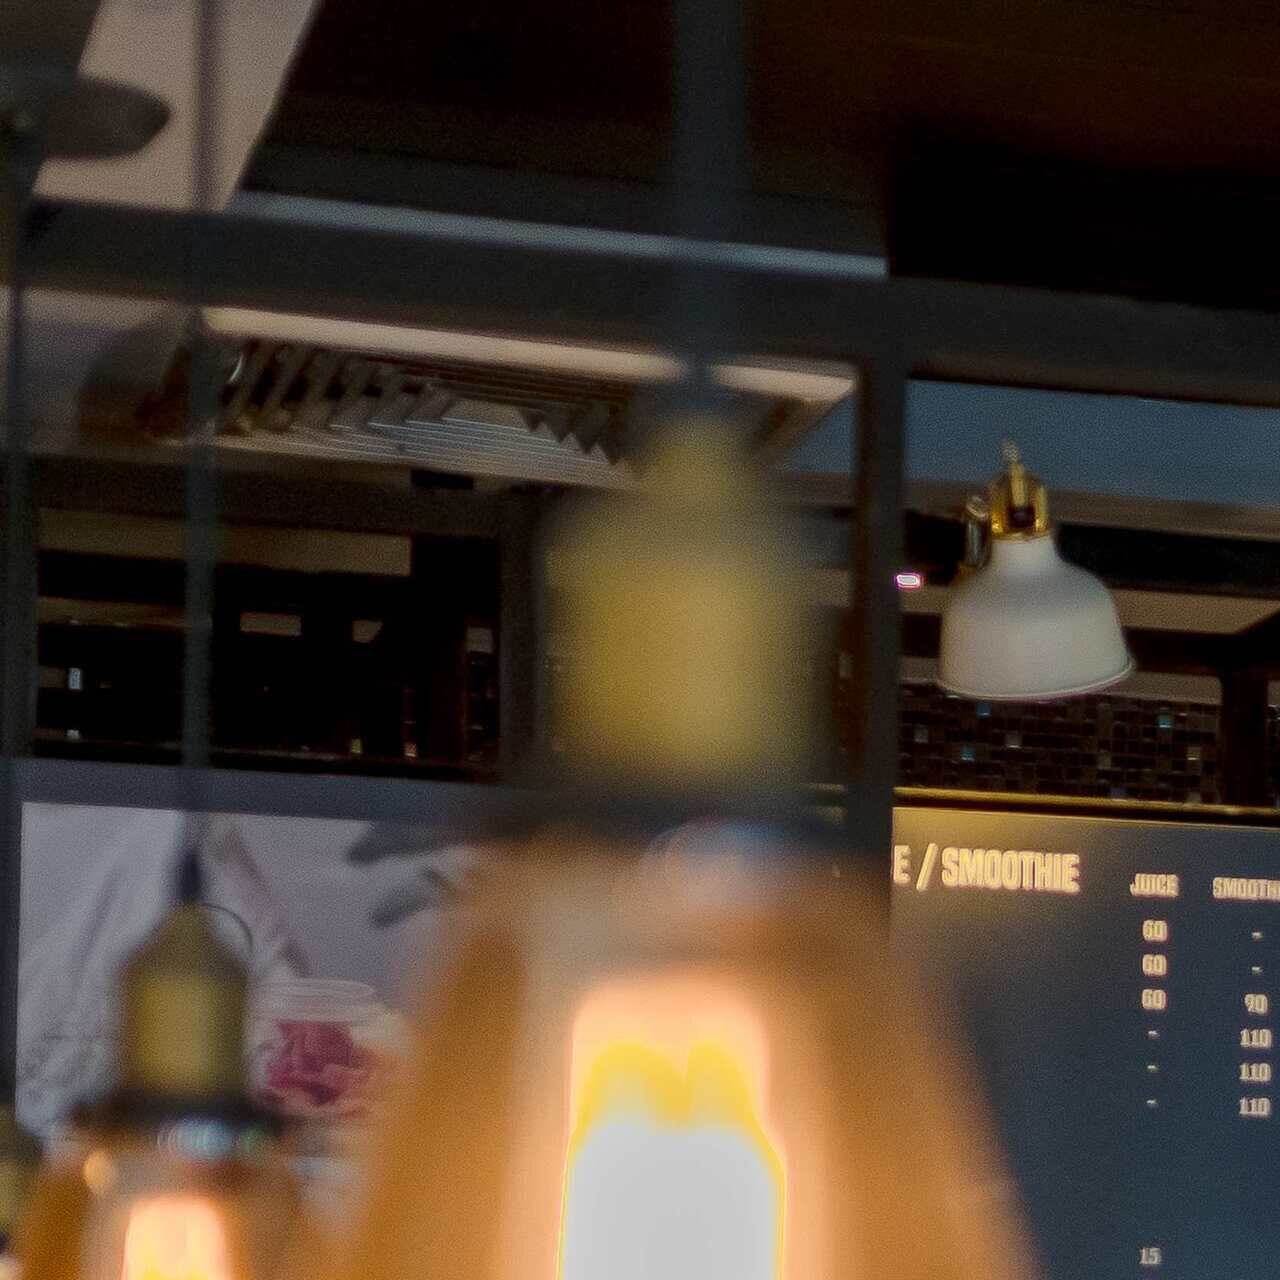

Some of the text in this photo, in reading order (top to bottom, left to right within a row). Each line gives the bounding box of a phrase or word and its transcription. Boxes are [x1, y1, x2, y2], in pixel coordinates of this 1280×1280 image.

[941, 846, 1082, 894] SMOOTHIE
[1130, 873, 1180, 897] JUICE
[1142, 919, 1168, 942] 60
[1142, 953, 1168, 976] 60
[1141, 988, 1167, 1010] 60
[1239, 1028, 1273, 1049] 110
[1239, 1063, 1273, 1083] 110
[1239, 1097, 1272, 1117] 110
[1138, 1247, 1162, 1265] 15
